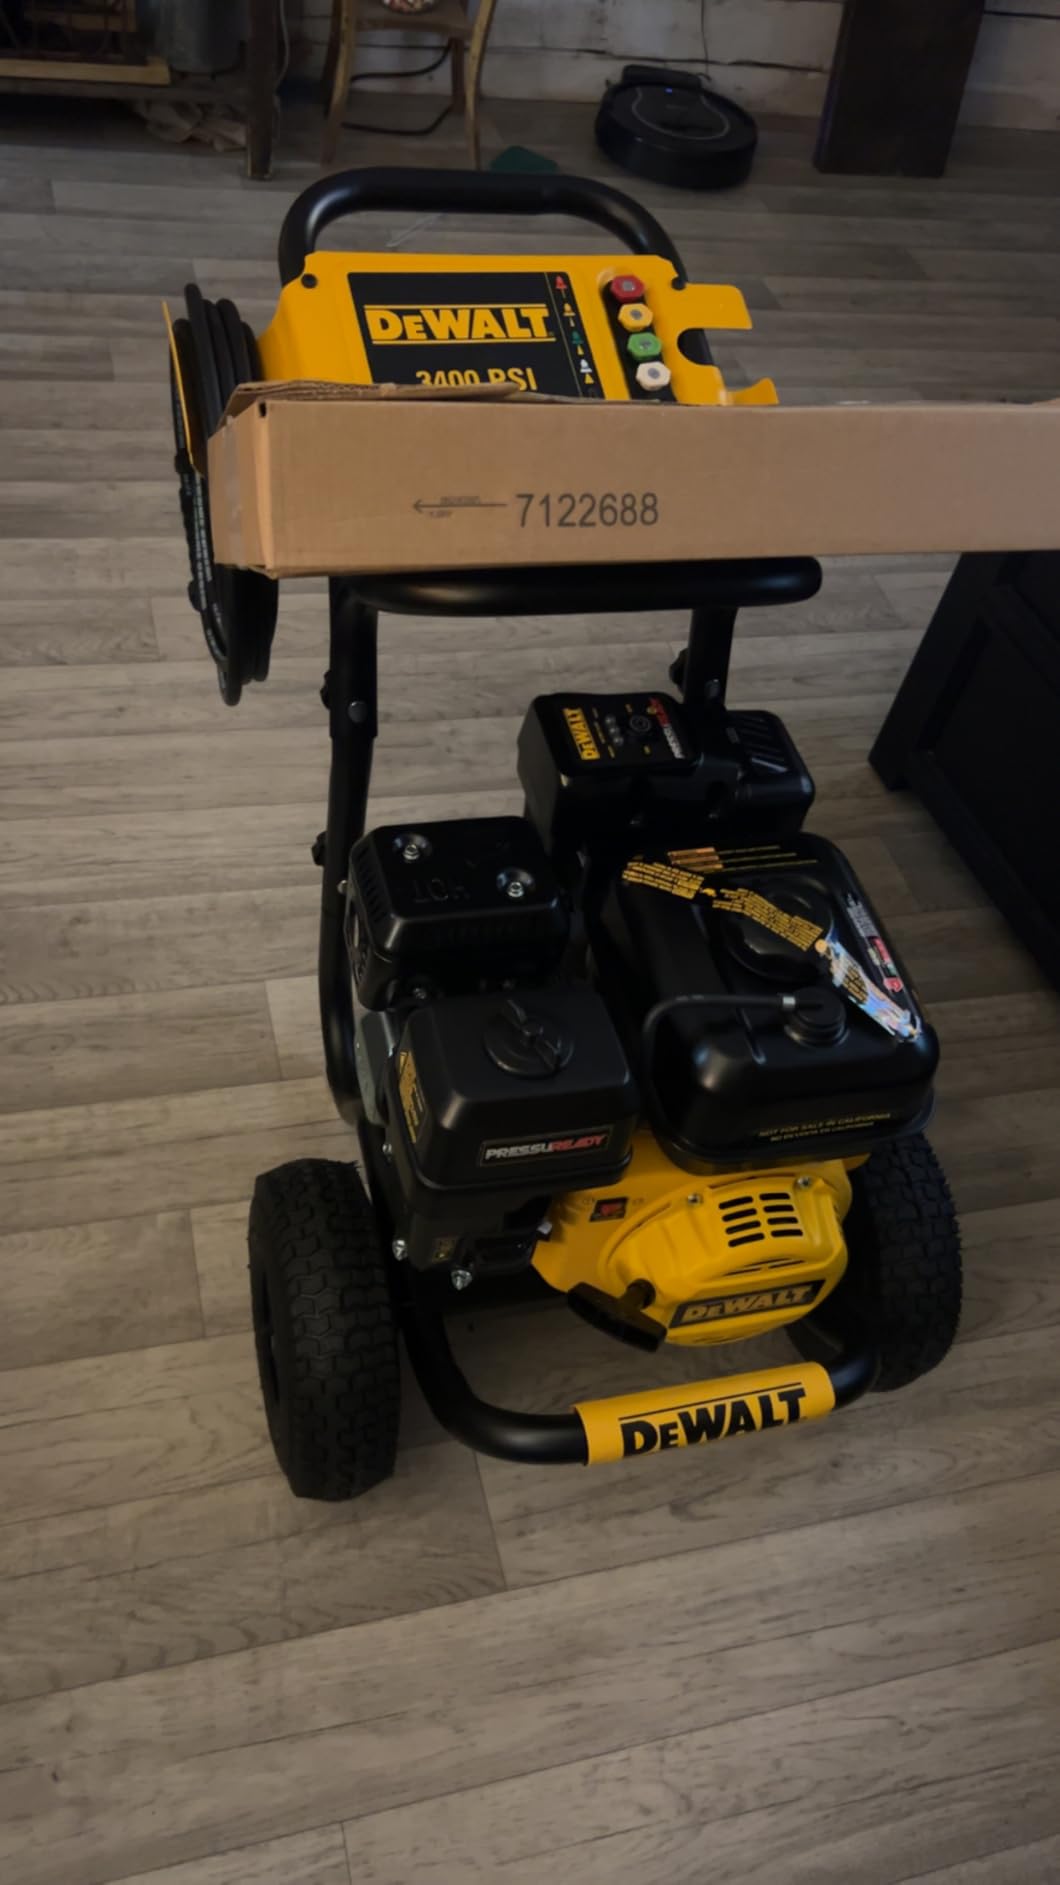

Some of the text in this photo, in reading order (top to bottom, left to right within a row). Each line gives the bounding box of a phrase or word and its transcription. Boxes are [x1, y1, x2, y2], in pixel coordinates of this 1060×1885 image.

[415, 367, 538, 391] 3400 PSI
[515, 492, 660, 527] 7122688
